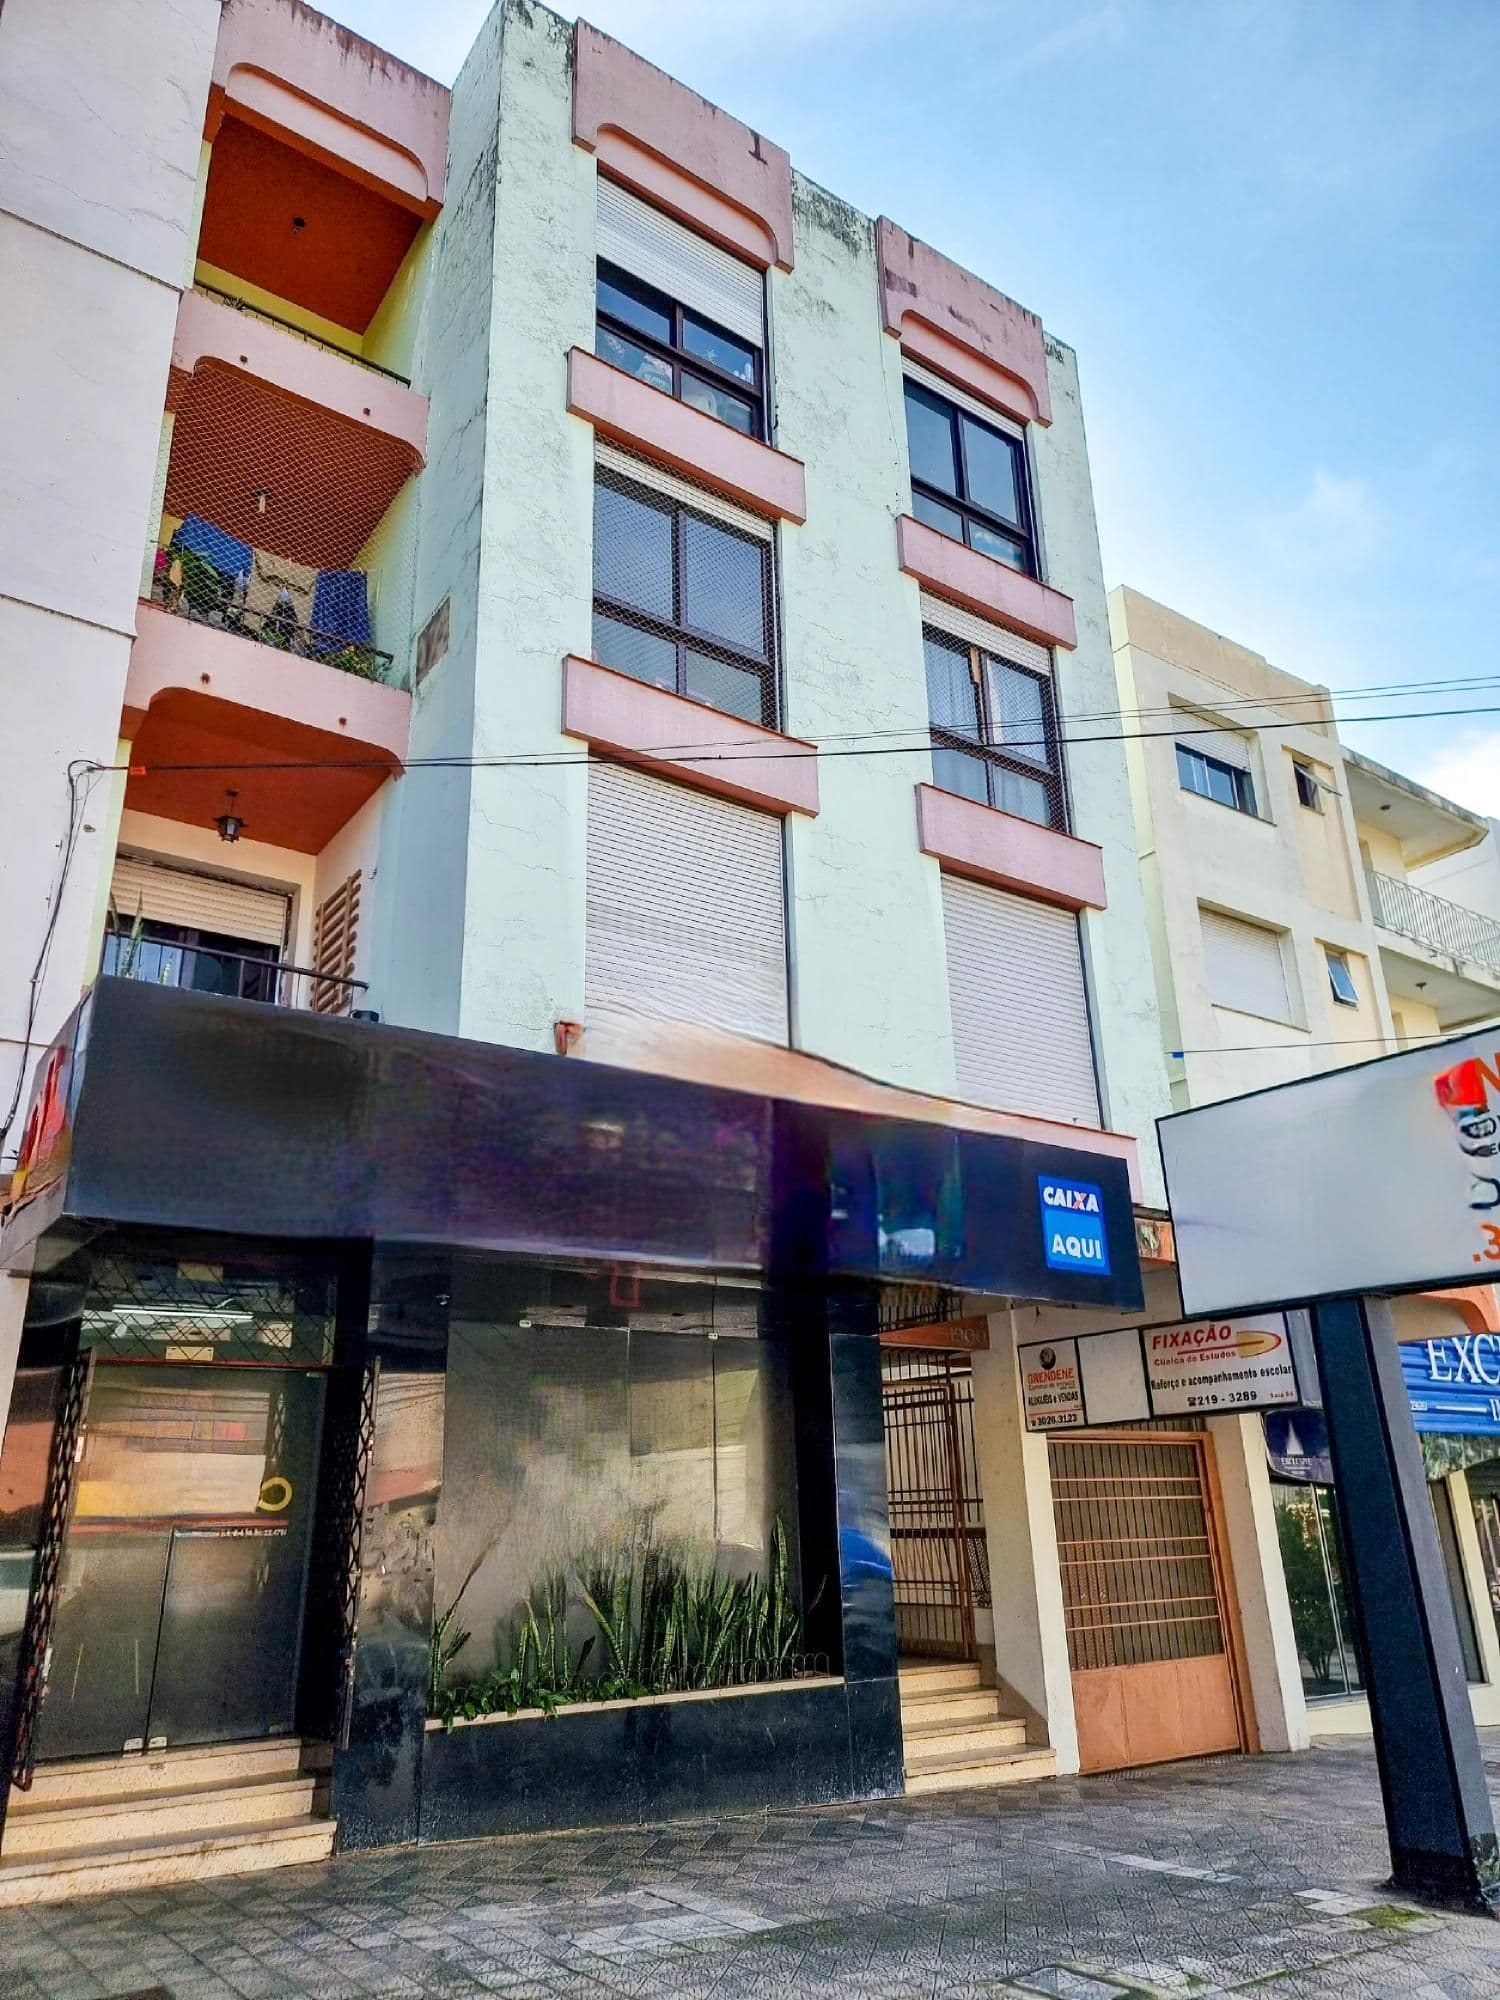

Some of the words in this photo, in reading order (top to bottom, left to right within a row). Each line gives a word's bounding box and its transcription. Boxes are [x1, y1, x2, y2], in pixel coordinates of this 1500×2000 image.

[1043, 1186, 1100, 1213] CAIXA
[1052, 1233, 1102, 1260] AQUI
[1152, 1323, 1232, 1350] FIXAÇÃO
[1187, 1355, 1199, 1363] de
[1200, 1351, 1237, 1362] Estudos
[1427, 1333, 1500, 1385] EXC
[1151, 1378, 1180, 1391] Reforço
[1181, 1378, 1187, 1387] e
[1188, 1368, 1258, 1386] acompanhamento
[1260, 1363, 1293, 1377] escolar
[1198, 1394, 1218, 1406] 219
[1230, 1391, 1258, 1403] 3289
